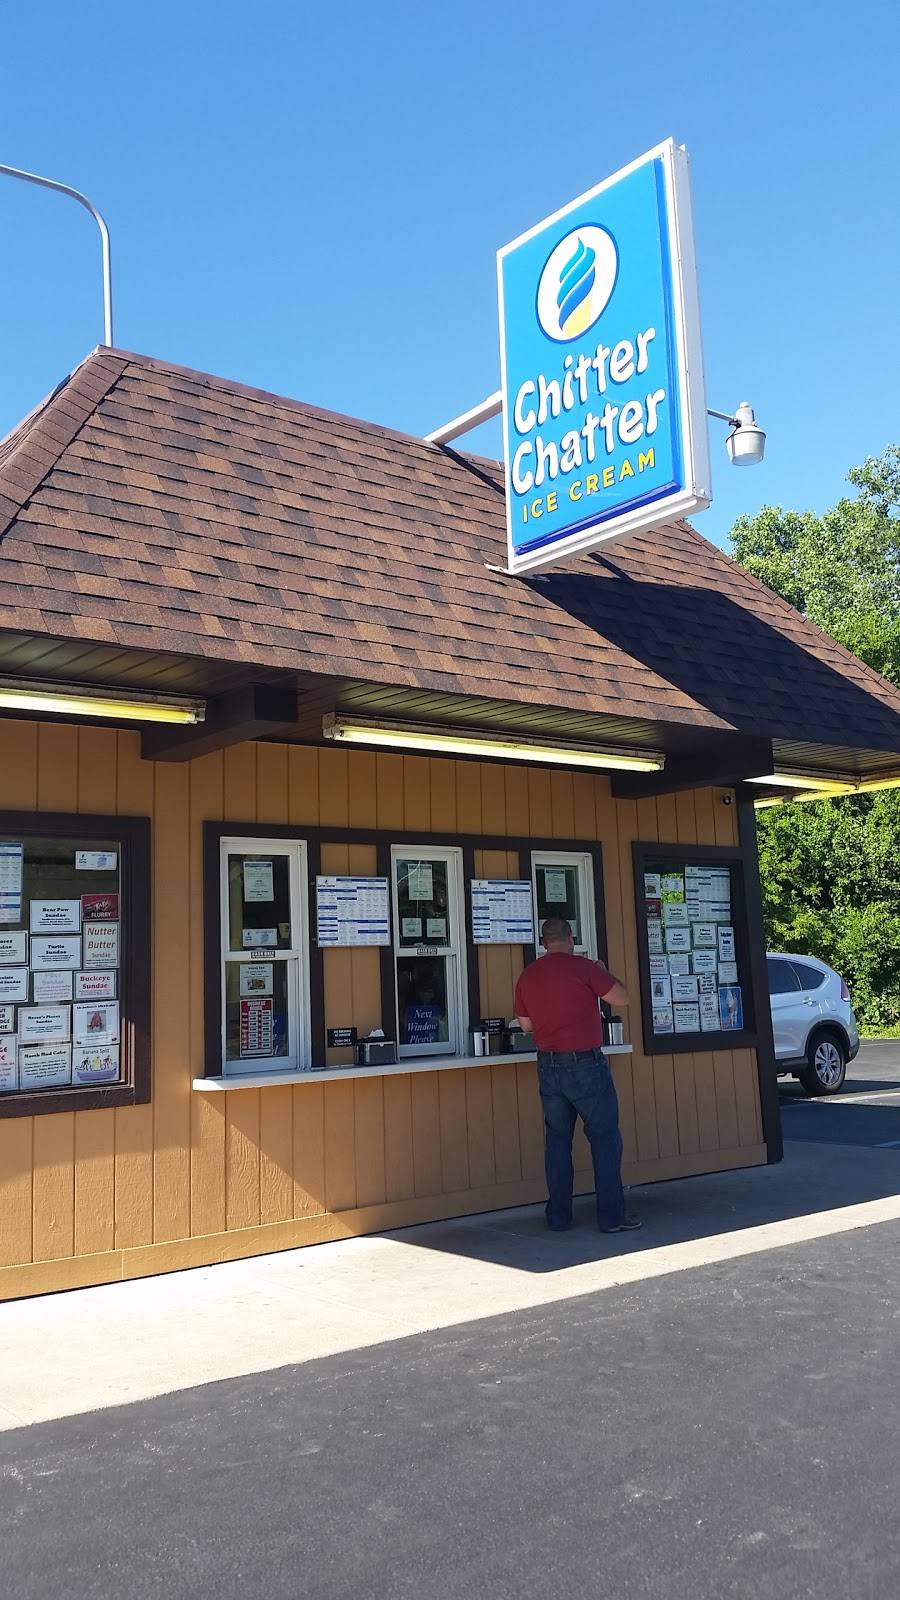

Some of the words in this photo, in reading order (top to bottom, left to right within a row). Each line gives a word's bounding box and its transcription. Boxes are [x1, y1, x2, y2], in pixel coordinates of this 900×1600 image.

[513, 326, 656, 435] Chitter
[511, 387, 666, 496] Chatter
[522, 486, 558, 523] ICE
[569, 447, 656, 501] CREAM
[87, 927, 116, 936] Nutter
[87, 941, 116, 949] Butter
[414, 1009, 433, 1018] Next
[407, 1021, 438, 1031] Window
